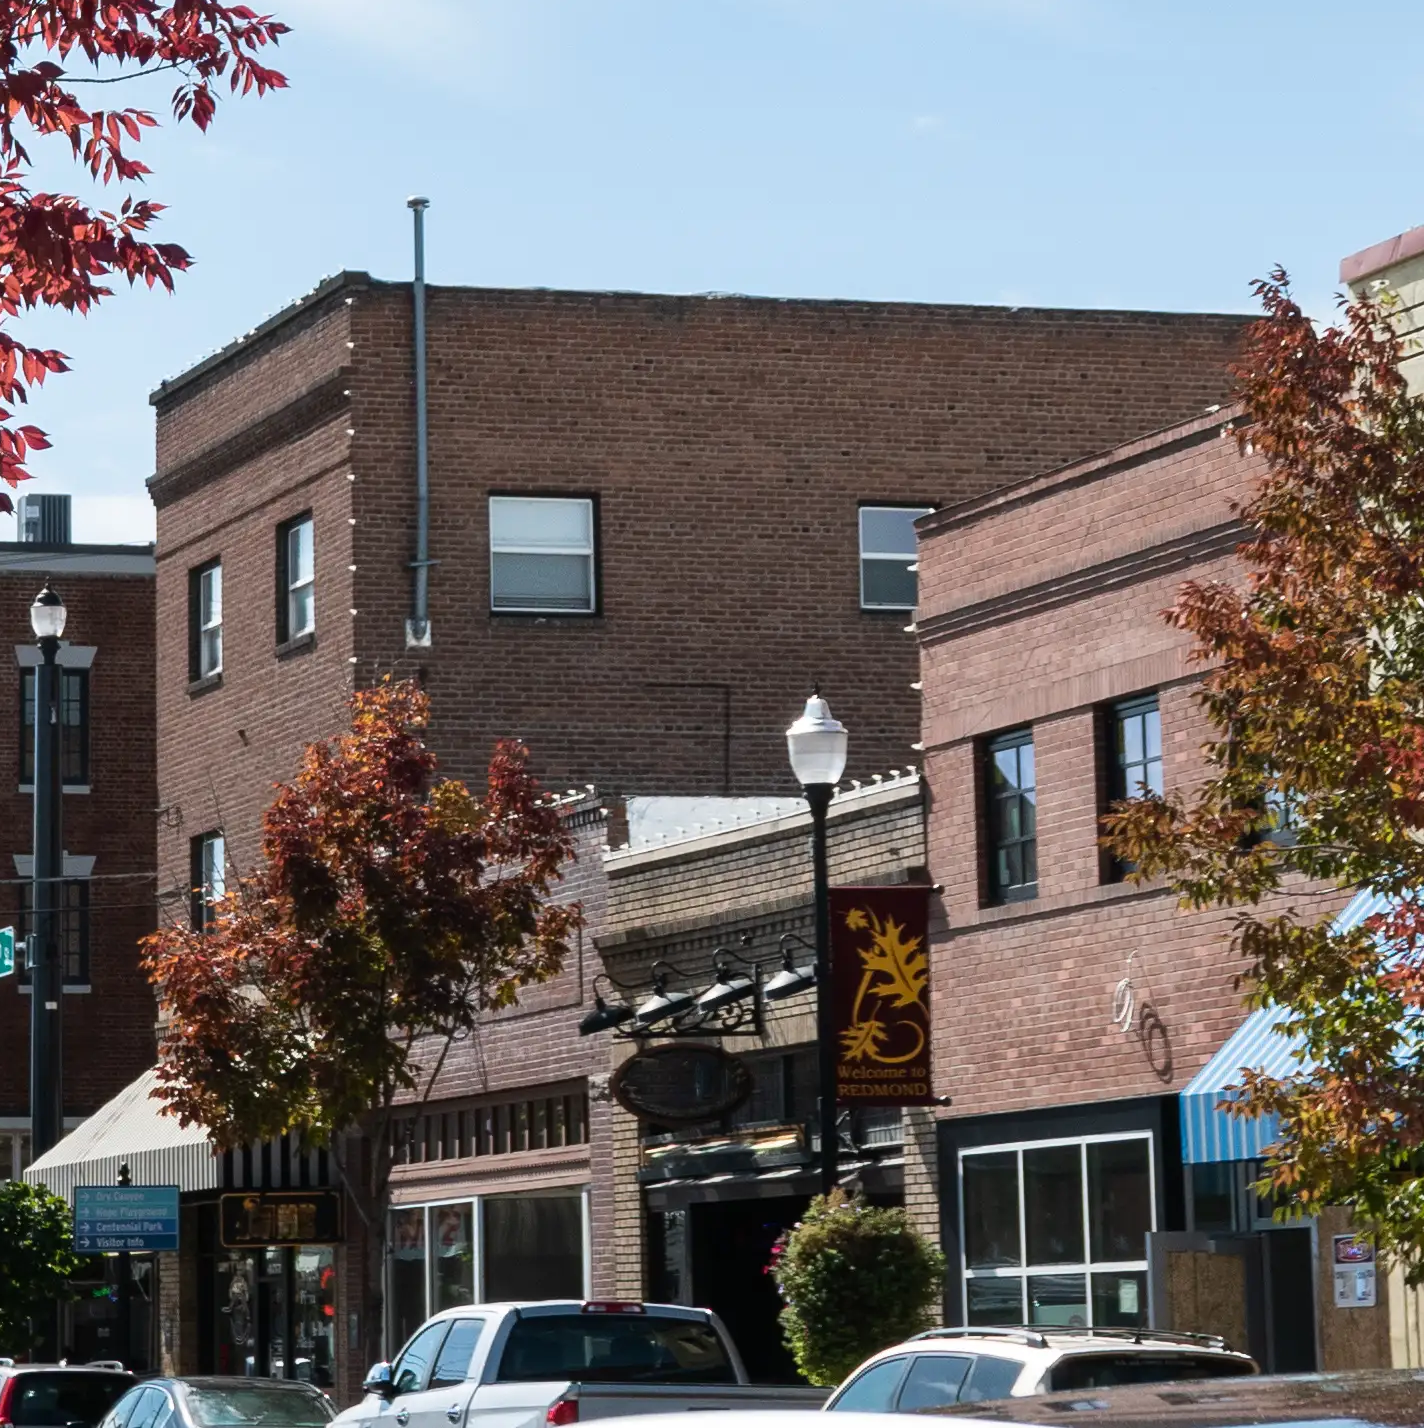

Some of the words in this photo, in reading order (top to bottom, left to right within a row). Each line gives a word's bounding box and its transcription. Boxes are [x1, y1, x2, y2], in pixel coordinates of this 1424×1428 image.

[838, 1066, 907, 1078] Welcome
[910, 1067, 926, 1078] to
[838, 1083, 928, 1096] REDMOND
[96, 1221, 142, 1232] Centennial
[143, 1221, 163, 1232] Park
[96, 1236, 125, 1247] Visitor
[127, 1236, 144, 1247] Info
